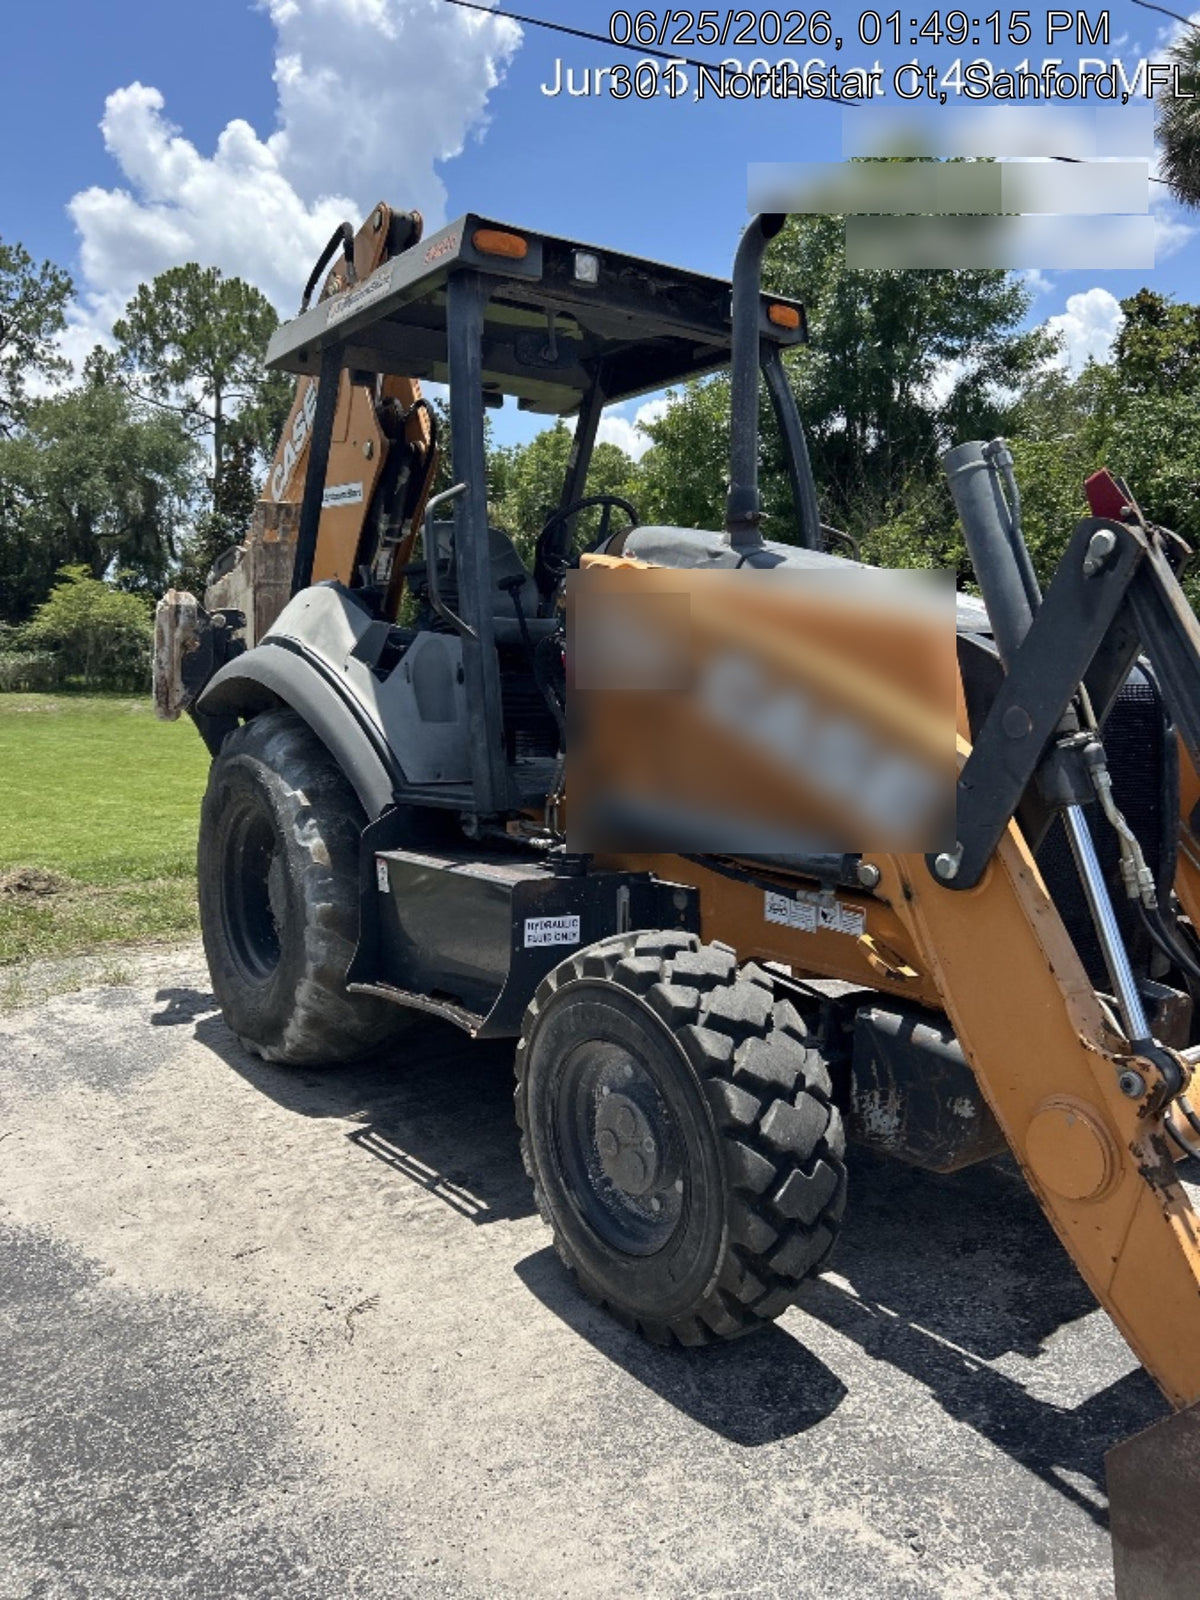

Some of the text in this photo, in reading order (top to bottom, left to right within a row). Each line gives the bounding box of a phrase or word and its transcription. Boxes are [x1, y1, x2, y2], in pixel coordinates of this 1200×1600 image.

[271, 378, 318, 503] CASE
[527, 918, 578, 932] HYDRAULIC
[527, 931, 578, 943] FLUID ONLY
